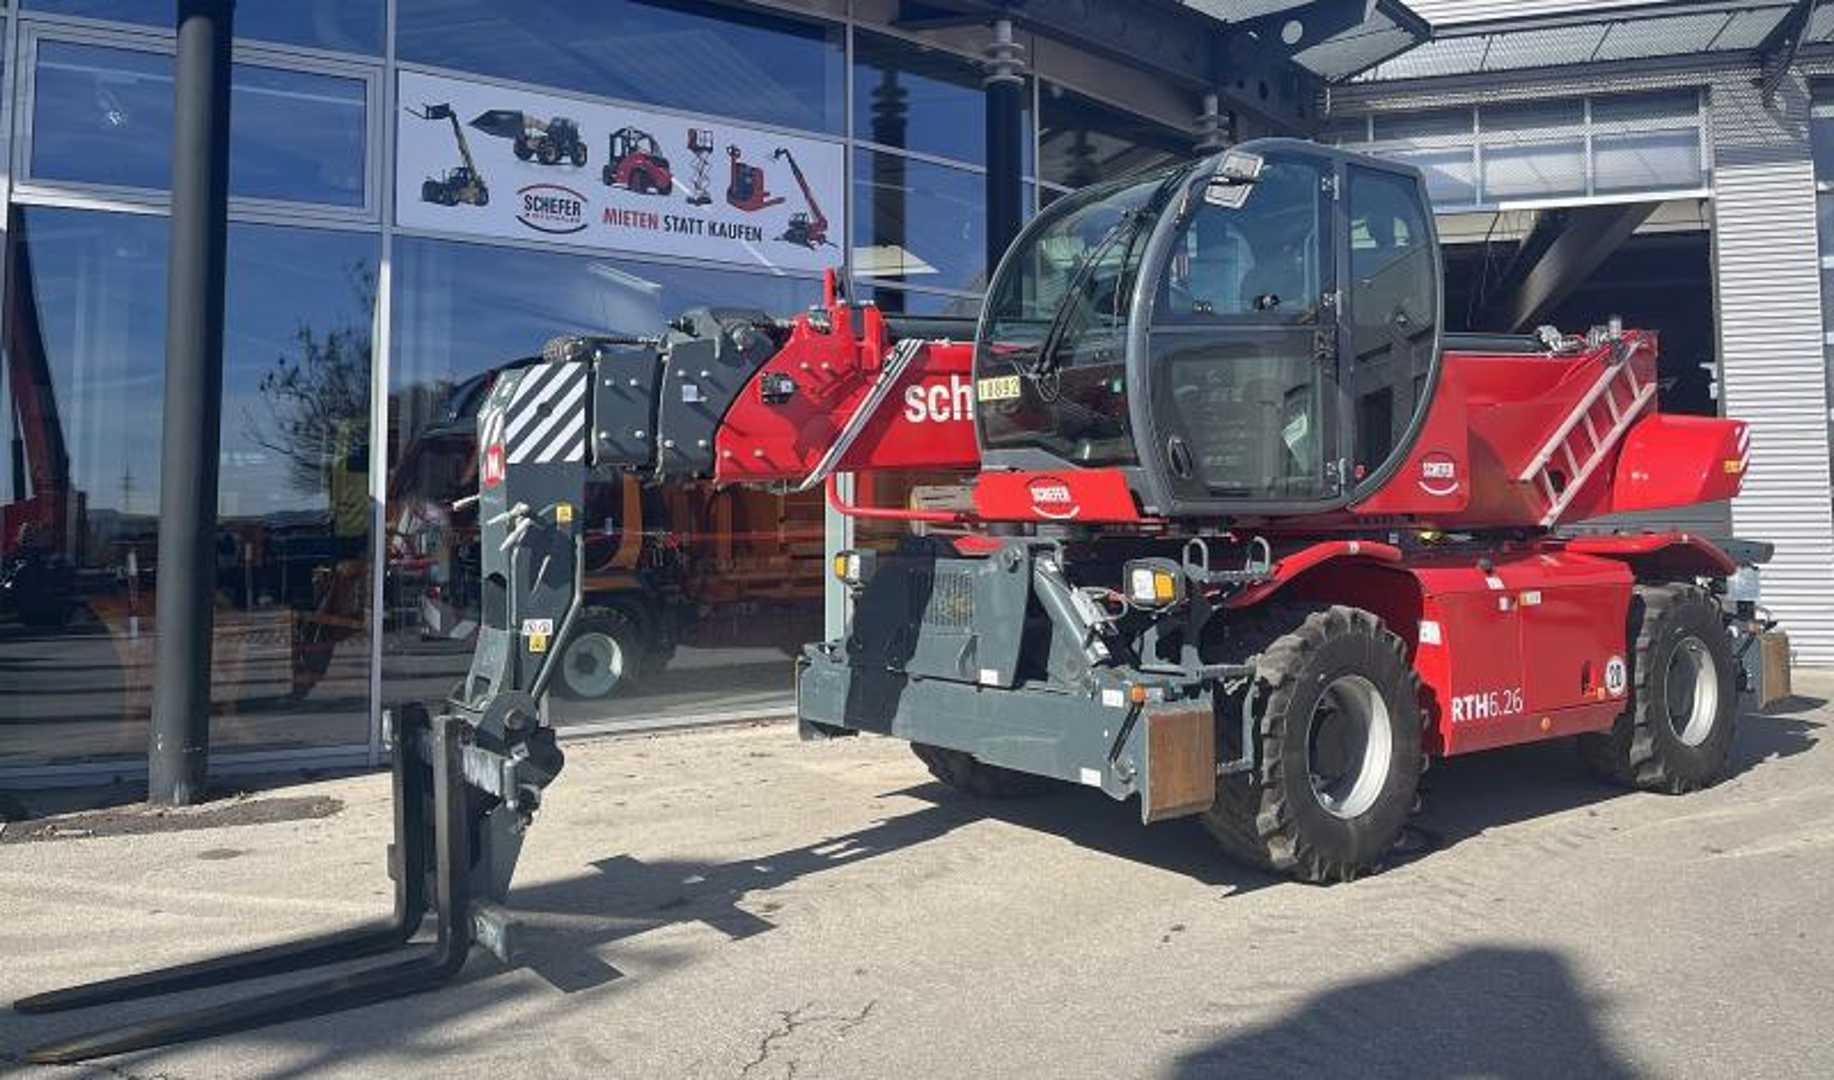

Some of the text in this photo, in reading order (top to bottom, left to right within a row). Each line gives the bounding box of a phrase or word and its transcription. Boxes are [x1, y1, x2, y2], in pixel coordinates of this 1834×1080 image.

[524, 194, 581, 216] SCHEFER
[603, 207, 659, 230] MIETEN
[664, 215, 704, 235] STATT
[708, 220, 762, 242] KAUFEN
[1608, 664, 1622, 688] 20
[1451, 688, 1524, 723] RTH6.26
